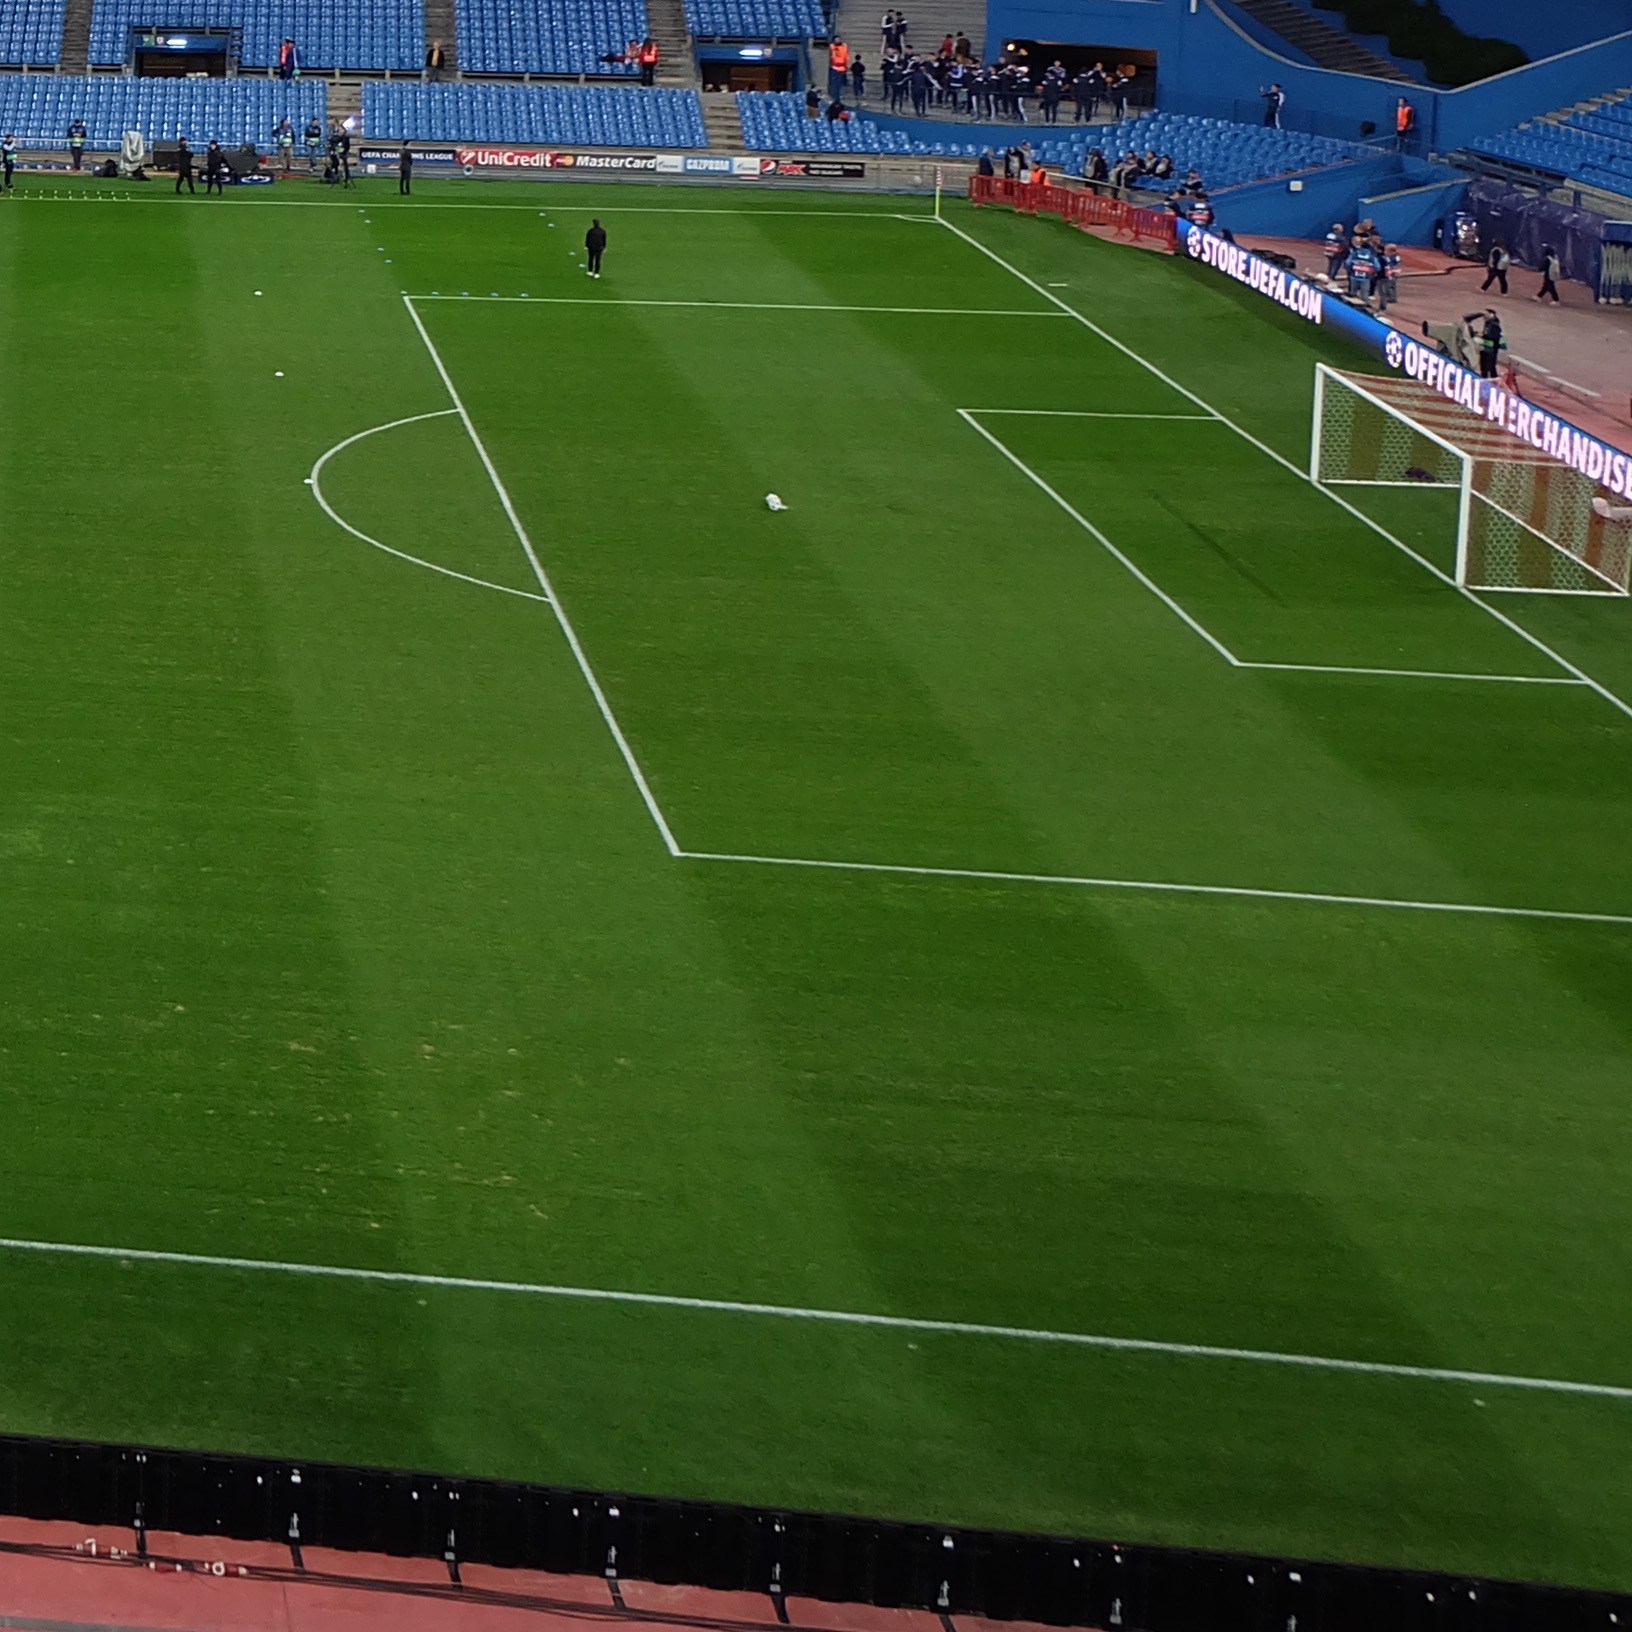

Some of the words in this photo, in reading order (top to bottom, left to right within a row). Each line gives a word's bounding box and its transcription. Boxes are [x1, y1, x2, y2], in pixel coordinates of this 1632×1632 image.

[477, 151, 552, 167] UniCredit
[576, 156, 656, 169] MasterCard
[1201, 233, 1322, 324] STORE.UEFA.COM
[1405, 342, 1484, 415] OFFICIAL
